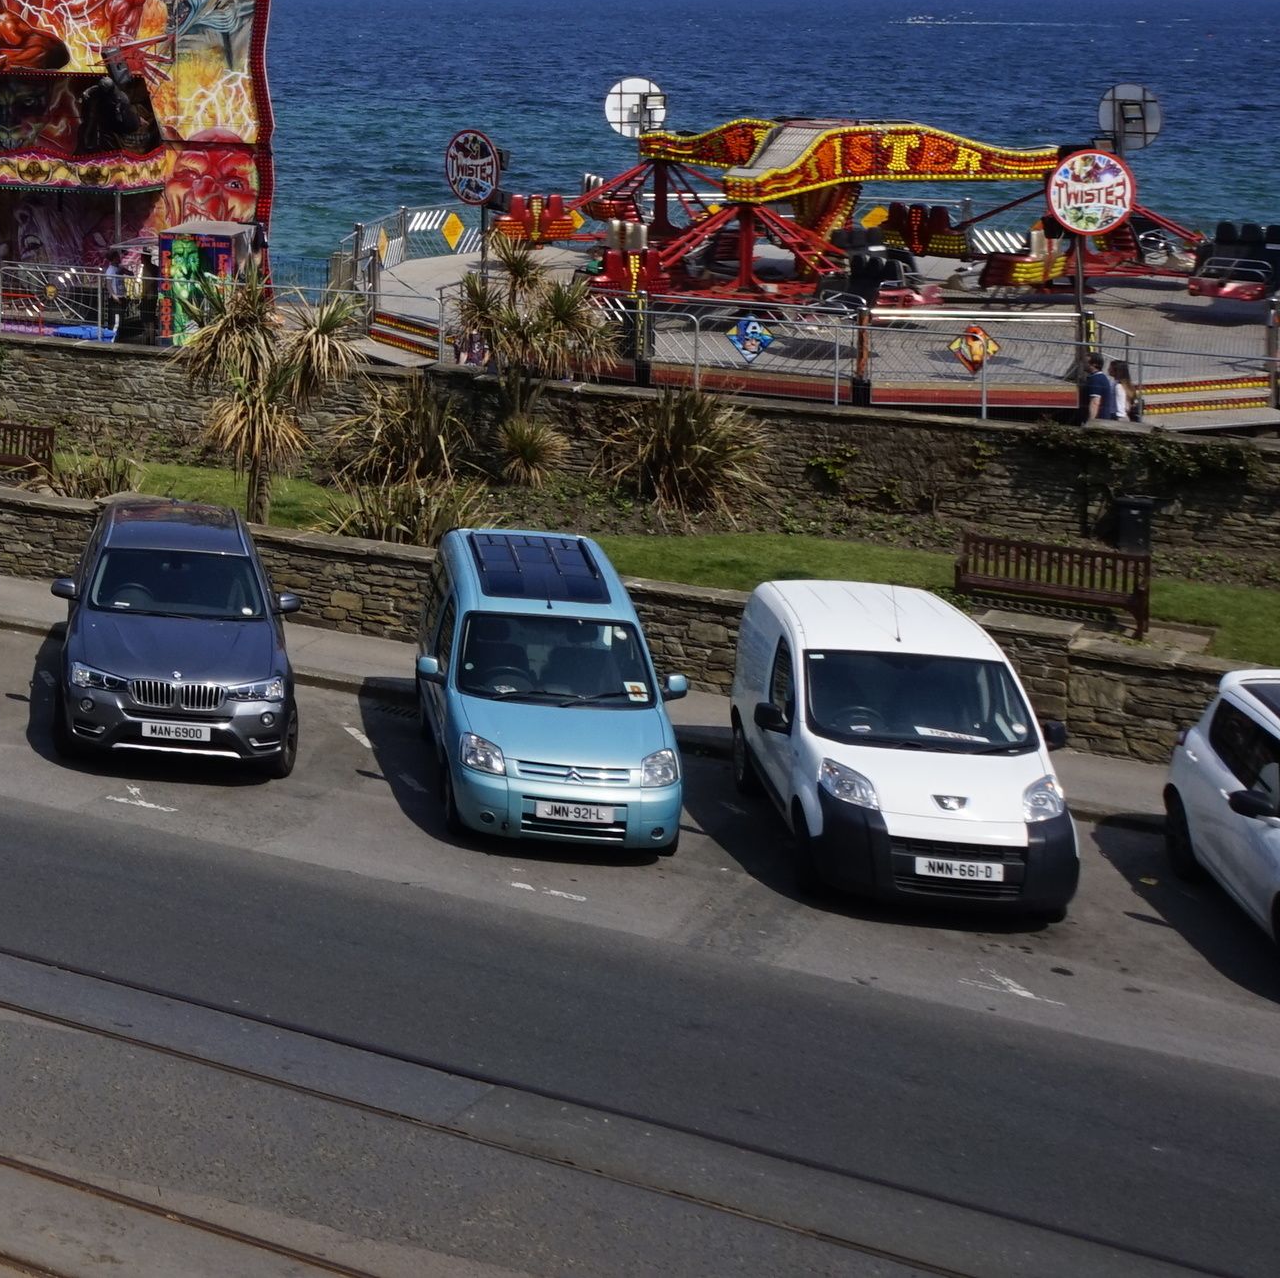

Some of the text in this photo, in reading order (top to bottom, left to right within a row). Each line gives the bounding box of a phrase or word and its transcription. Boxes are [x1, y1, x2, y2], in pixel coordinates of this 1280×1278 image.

[449, 153, 494, 186] TWISTER
[1055, 178, 1127, 209] TWISTER
[150, 724, 203, 739] MAN-6900
[545, 803, 604, 821] JMN-921-L
[927, 859, 993, 879] NMN-661-D
